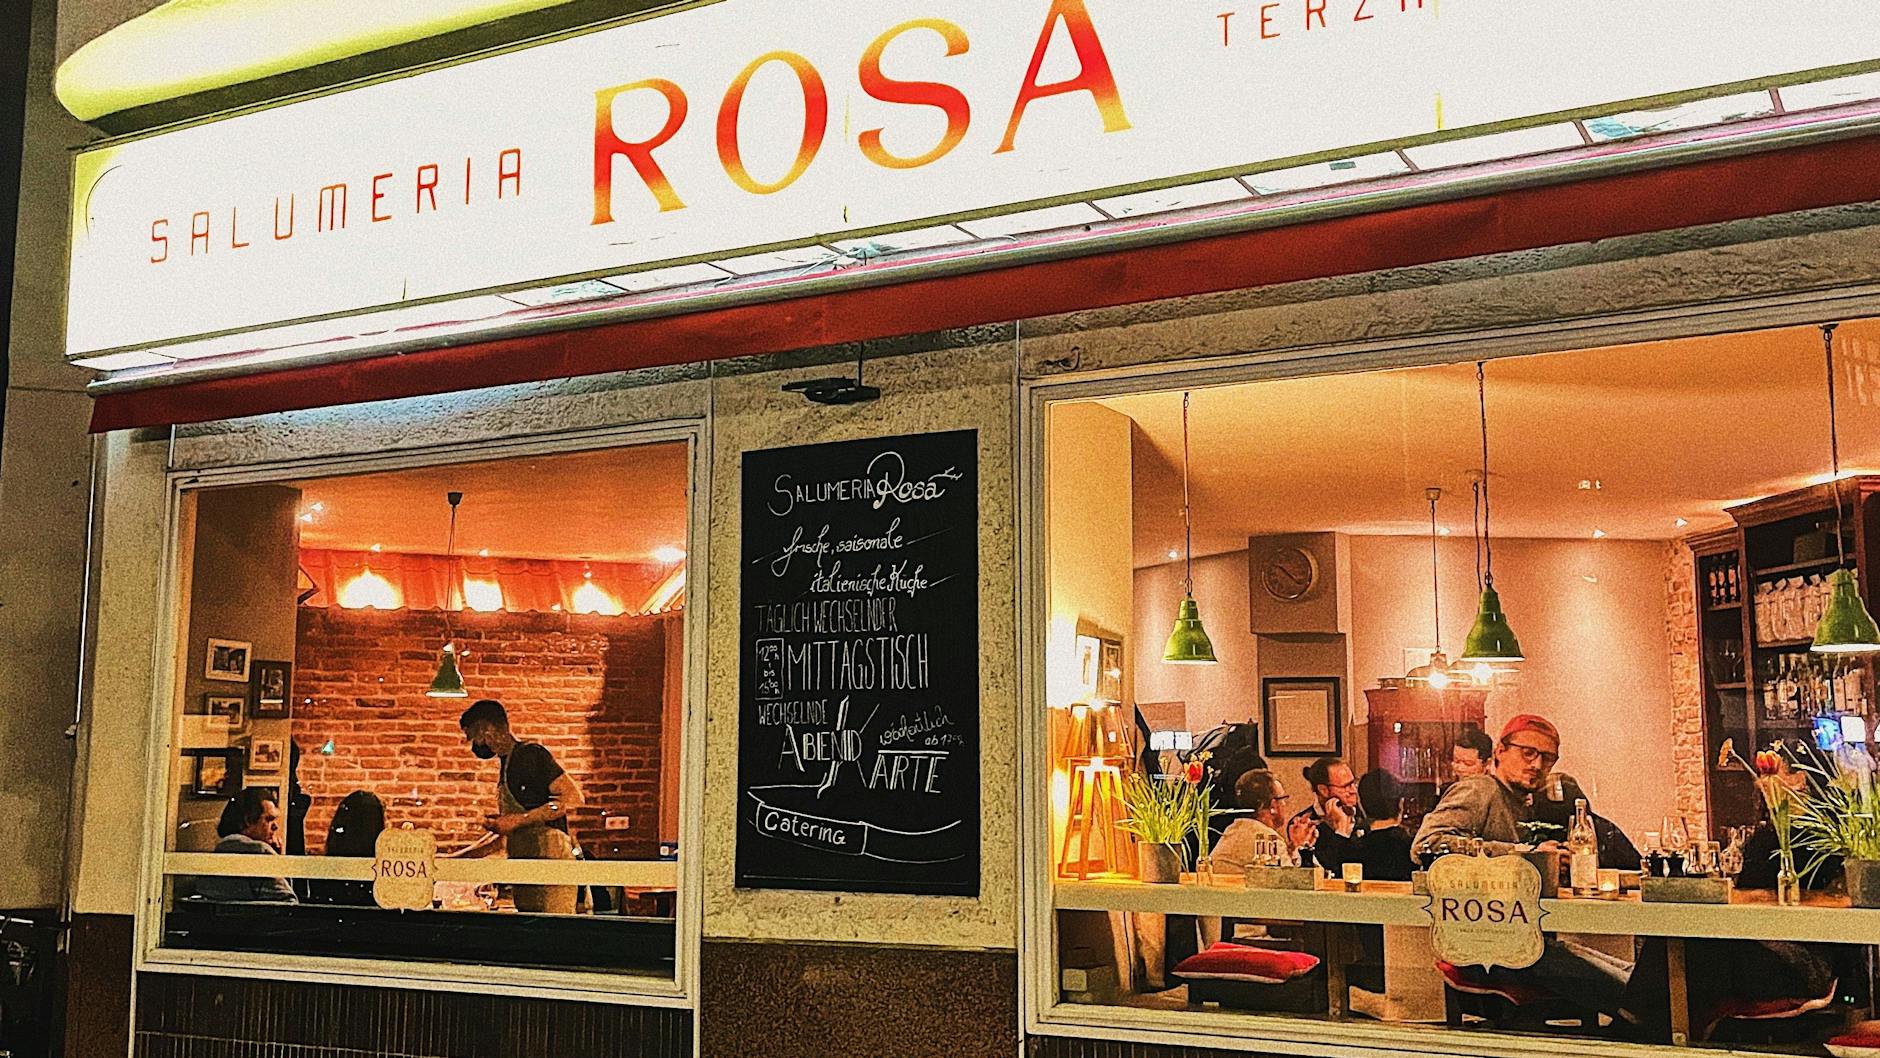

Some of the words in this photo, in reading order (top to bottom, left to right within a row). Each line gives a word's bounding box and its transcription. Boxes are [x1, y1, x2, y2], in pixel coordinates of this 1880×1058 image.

[150, 147, 522, 264] SALUMERIA
[591, 0, 1132, 225] ROSA
[1217, 0, 1425, 47] TERZ
[867, 451, 950, 510] Rosa
[813, 596, 898, 633] WECHSELNDER
[787, 633, 929, 691] MITTAGSTISCH
[758, 699, 828, 726] WECHSELNDE
[381, 860, 427, 878] ROSA
[1441, 898, 1529, 924] ROSA
